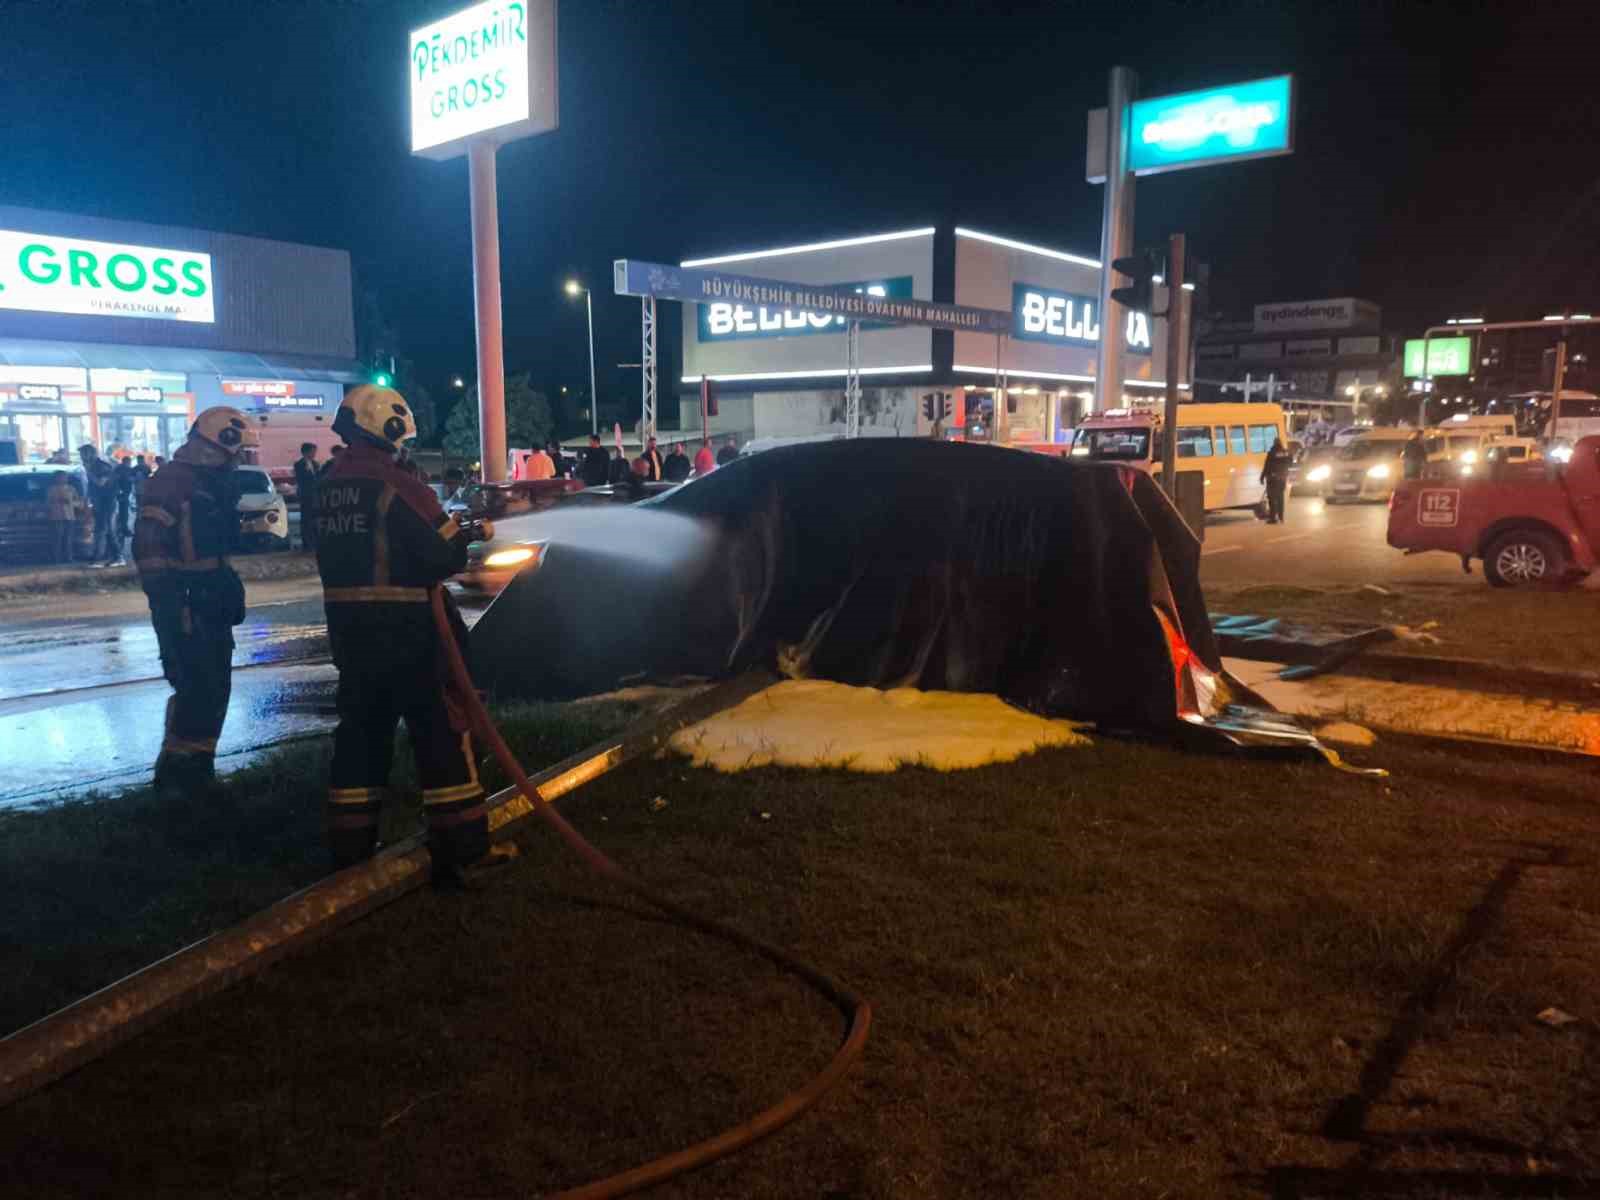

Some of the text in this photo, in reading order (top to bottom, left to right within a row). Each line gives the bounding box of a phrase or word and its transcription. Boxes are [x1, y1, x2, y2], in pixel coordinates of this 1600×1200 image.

[430, 68, 508, 118] GROSS
[18, 244, 207, 298] GROSS
[702, 277, 791, 305] BÜYÜKŞEHİR
[796, 290, 864, 313] BELEDİYESİ
[926, 308, 980, 326] MAHALLESİ
[1022, 292, 1150, 348] BELLA
[1426, 495, 1451, 511] 112
